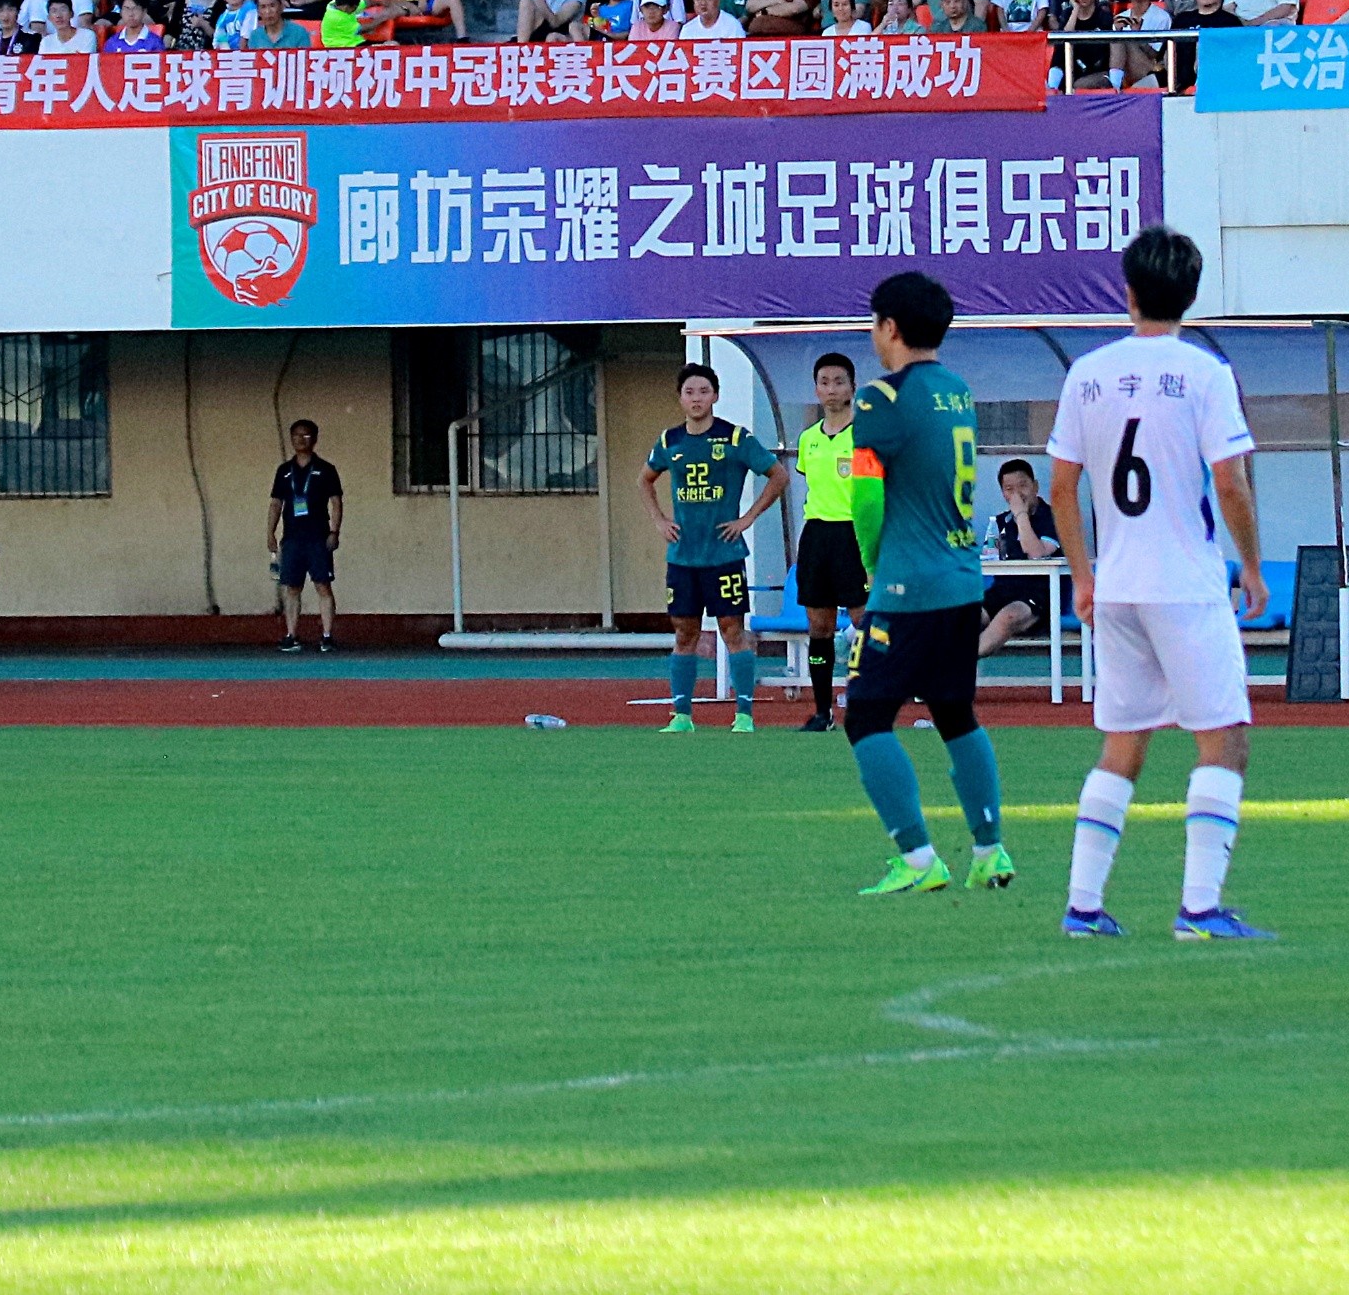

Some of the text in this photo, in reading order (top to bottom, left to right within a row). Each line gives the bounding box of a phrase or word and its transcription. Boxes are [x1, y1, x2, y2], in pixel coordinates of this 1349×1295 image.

[208, 144, 296, 183] LANGFANG
[192, 183, 313, 218] CITY OF GLORY
[339, 157, 1141, 265] 廊坊荣耀之城足球俱乐部
[685, 462, 709, 486] 22
[1111, 417, 1152, 518] 6
[719, 573, 743, 598] 22
